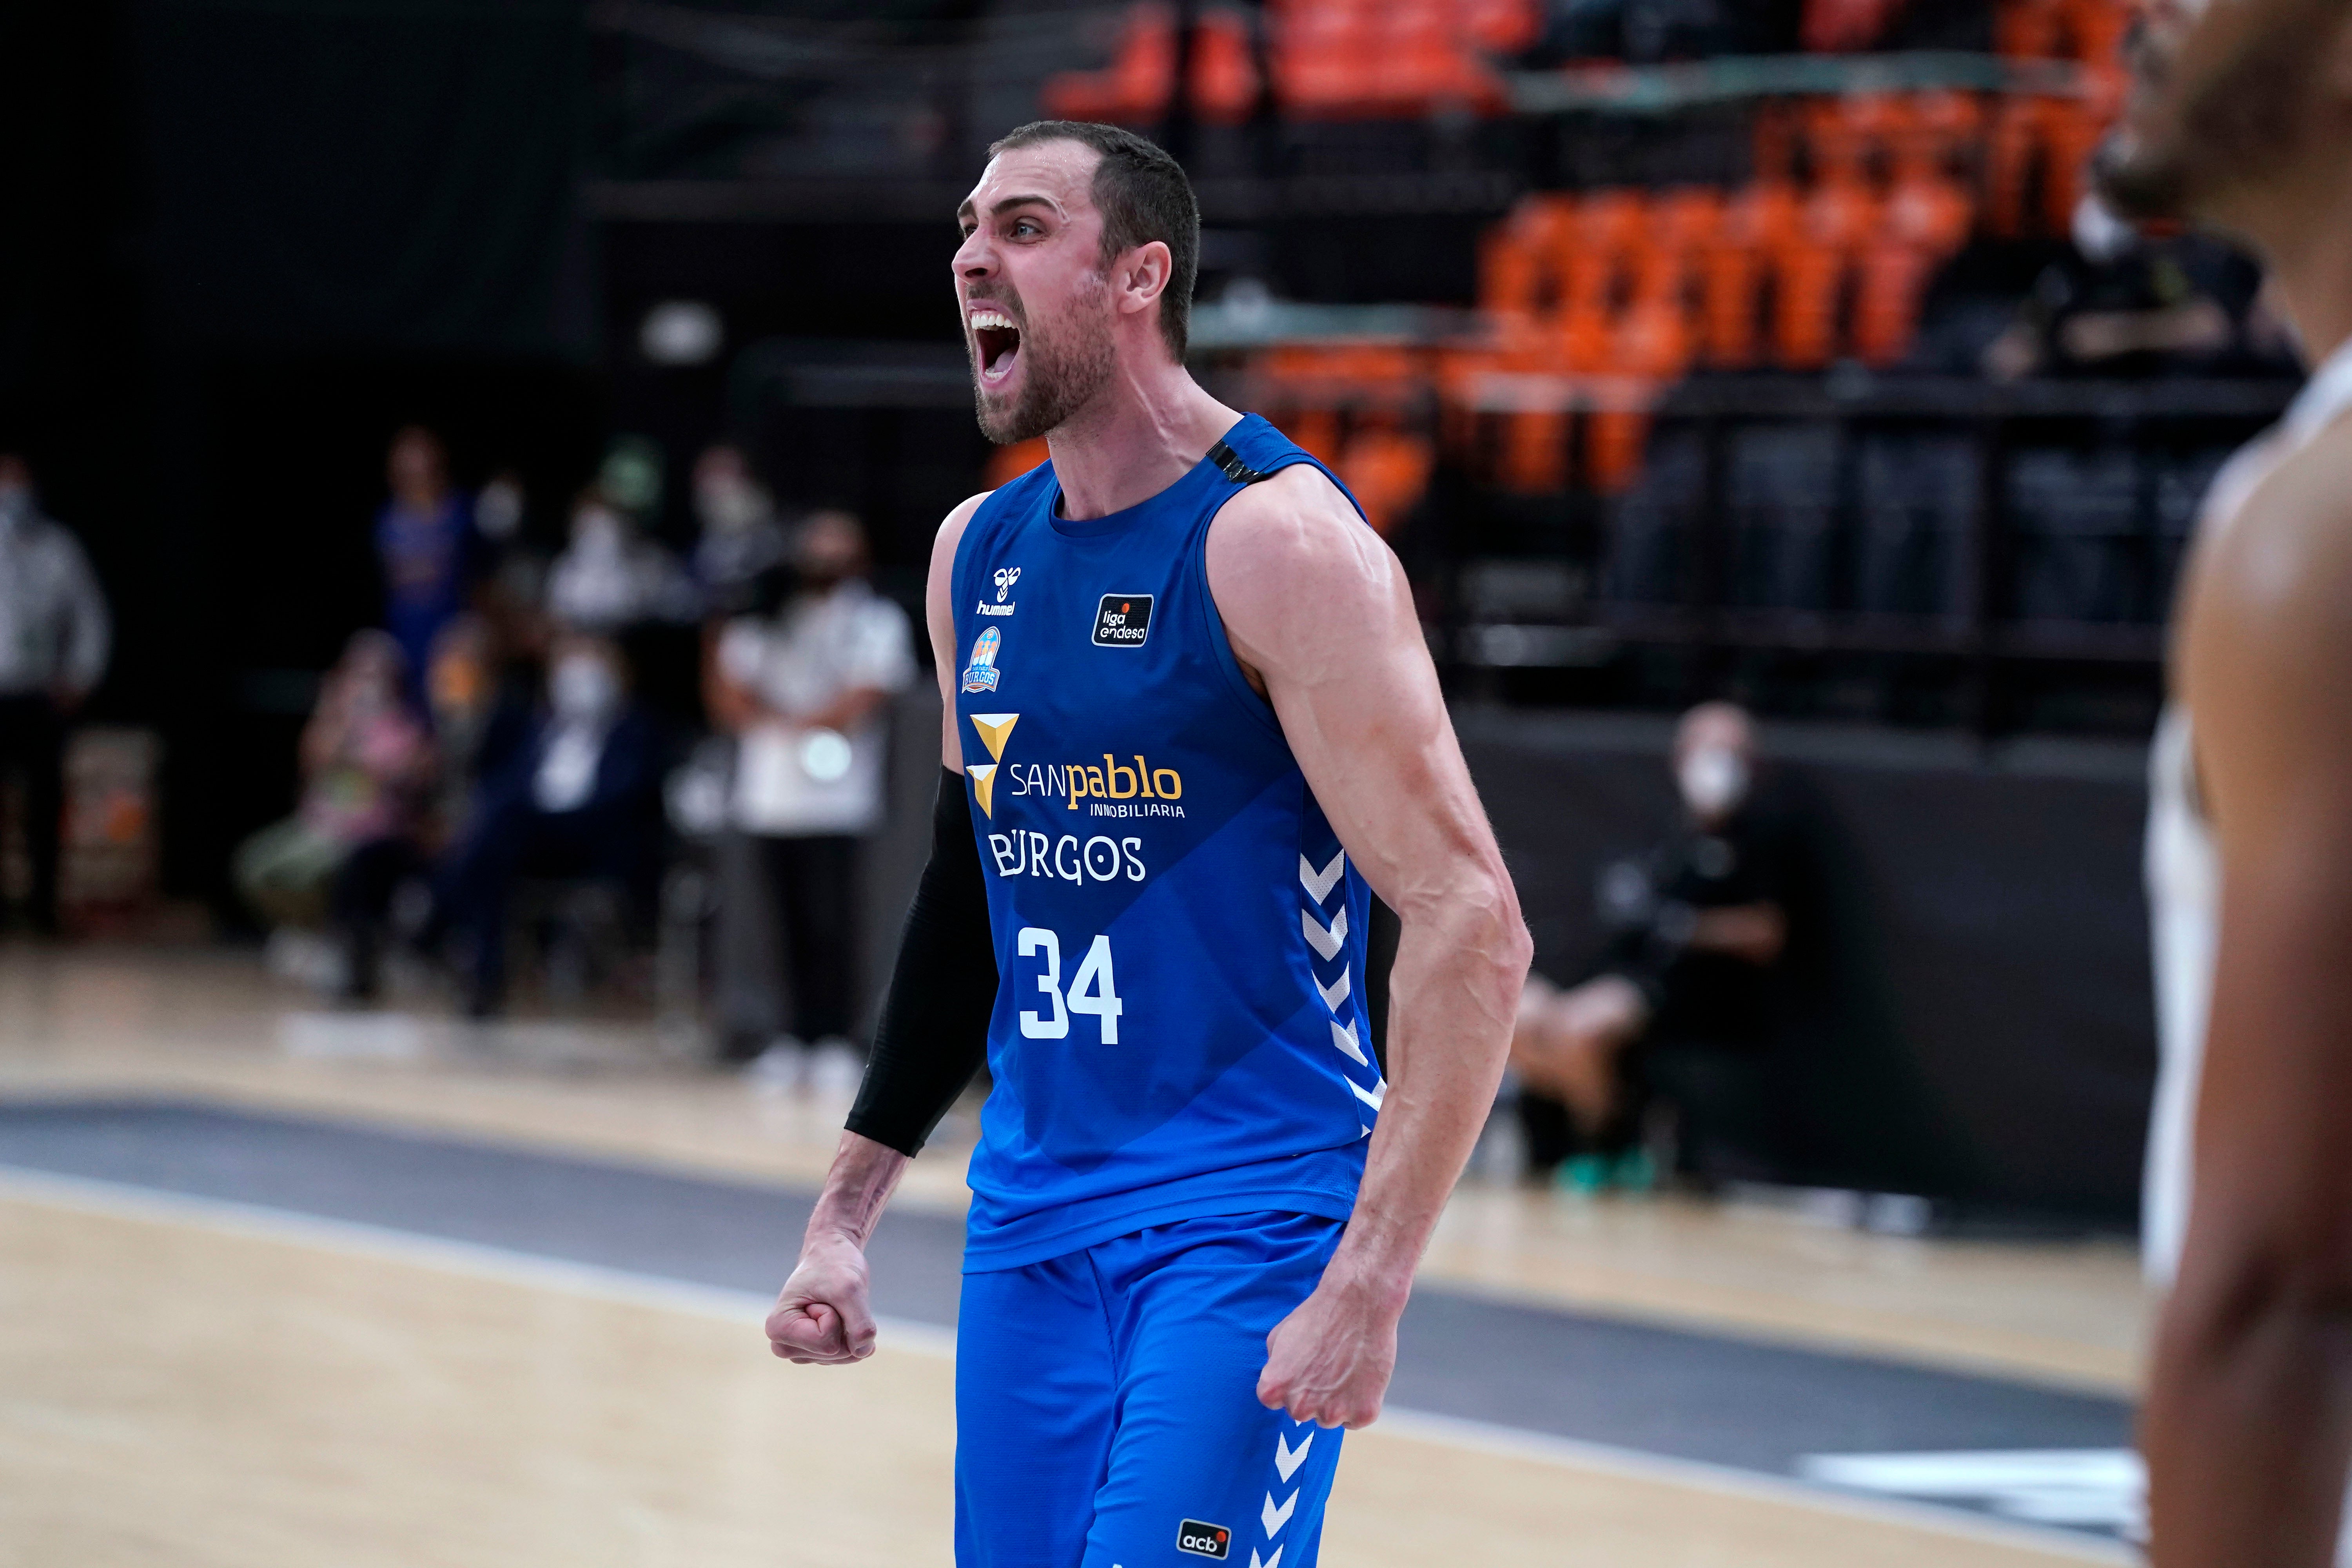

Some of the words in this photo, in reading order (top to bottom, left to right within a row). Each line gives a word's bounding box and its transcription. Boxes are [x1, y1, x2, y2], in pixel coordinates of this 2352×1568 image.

[976, 600, 1015, 616] hummel
[1103, 610, 1125, 626] liga
[1100, 625, 1145, 639] endesa
[965, 671, 995, 685] BURGOS
[1090, 804, 1185, 818] INMOBILIARIA
[988, 829, 1145, 886] BURGOS
[1018, 927, 1123, 1045] 34
[1183, 1535, 1218, 1552] acb
